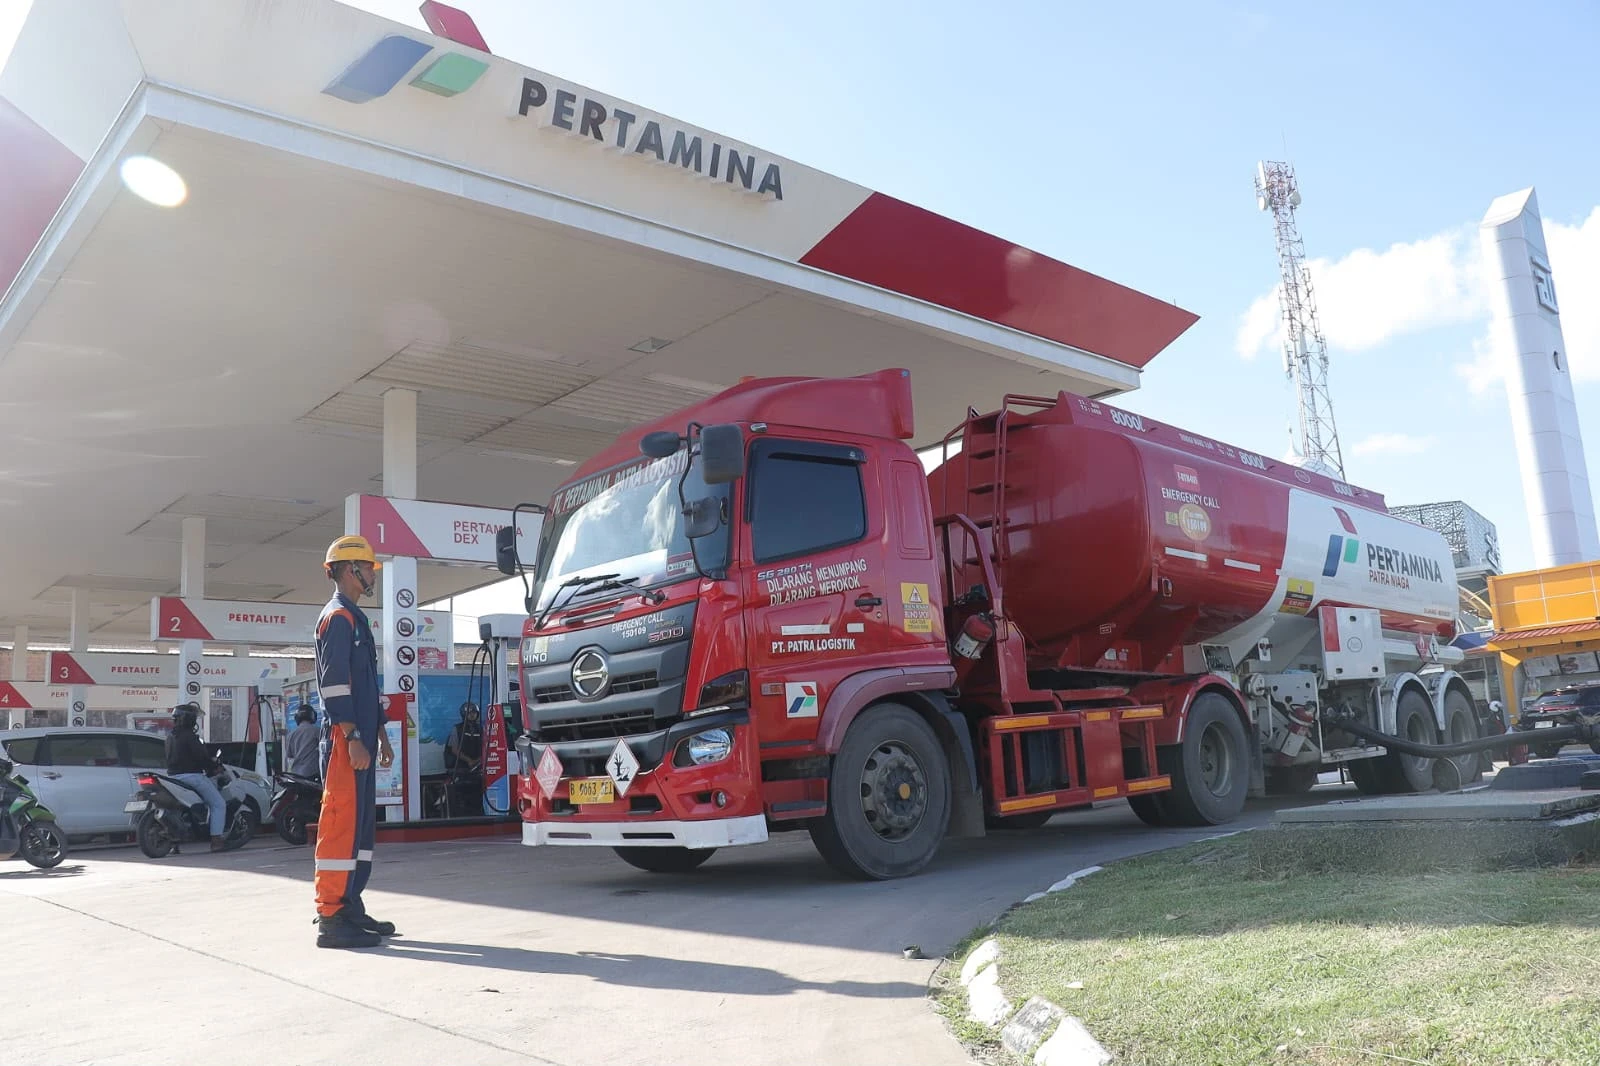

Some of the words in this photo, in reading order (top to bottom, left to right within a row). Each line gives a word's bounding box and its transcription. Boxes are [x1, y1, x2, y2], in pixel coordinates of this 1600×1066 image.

[518, 77, 783, 201] PERTAMINA
[1161, 487, 1202, 505] EMERGENCY
[1203, 496, 1220, 509] CALL
[377, 523, 385, 543] 1
[454, 520, 523, 537] PERTAMA
[454, 533, 479, 544] DEX
[1366, 543, 1443, 583] PERTAMINA
[757, 570, 775, 581] SG
[767, 571, 813, 593] DILARANG
[816, 559, 867, 580] MENUMPANG
[1369, 569, 1390, 586] PATRA
[1391, 573, 1410, 590] NIAGA
[769, 585, 816, 607] DILARANG
[819, 575, 861, 595] MEROKOK
[170, 616, 181, 632] 2
[228, 613, 287, 624] PERTALITE
[611, 616, 648, 633] EMERGENCY
[648, 612, 665, 625] CALL
[622, 626, 647, 639] 150109
[648, 626, 684, 642] 500
[772, 641, 786, 653] PT.
[787, 639, 815, 652] PATRA
[816, 638, 856, 651] LOGISTIK
[523, 652, 547, 665] HINO
[60, 666, 69, 679] 3
[111, 666, 160, 674] PERTALITE
[203, 668, 226, 676] OLAR
[1, 694, 9, 704] 4
[122, 689, 158, 697] PERTAMAX
[570, 782, 575, 796] B
